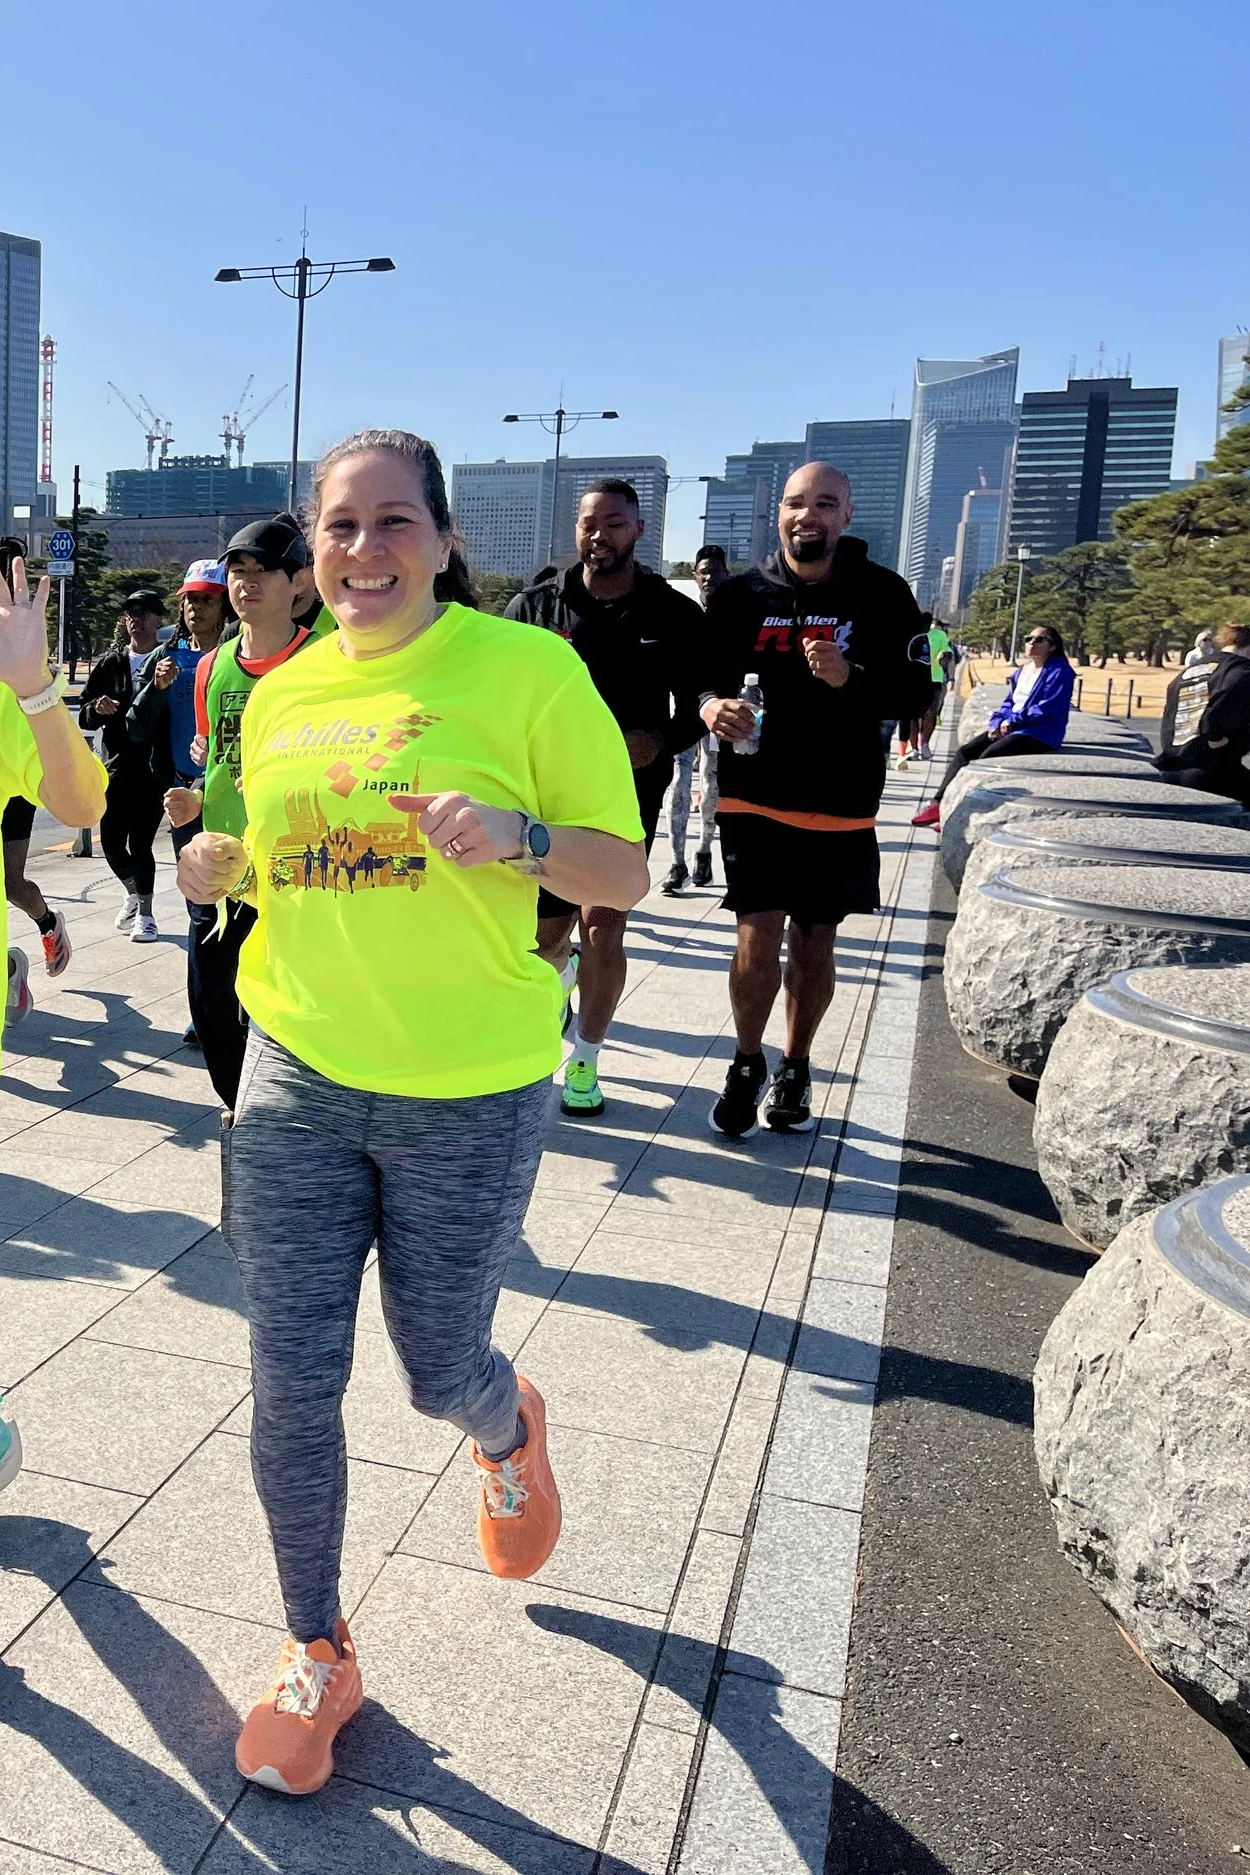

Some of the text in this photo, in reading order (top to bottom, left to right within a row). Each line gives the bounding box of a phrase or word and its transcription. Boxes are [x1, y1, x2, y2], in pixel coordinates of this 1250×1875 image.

[52, 539, 71, 551] 301
[763, 615, 838, 627] Blac Men
[264, 719, 381, 756] Achilles
[277, 747, 370, 759] INTERNATIONAL
[362, 779, 410, 794] Japan
